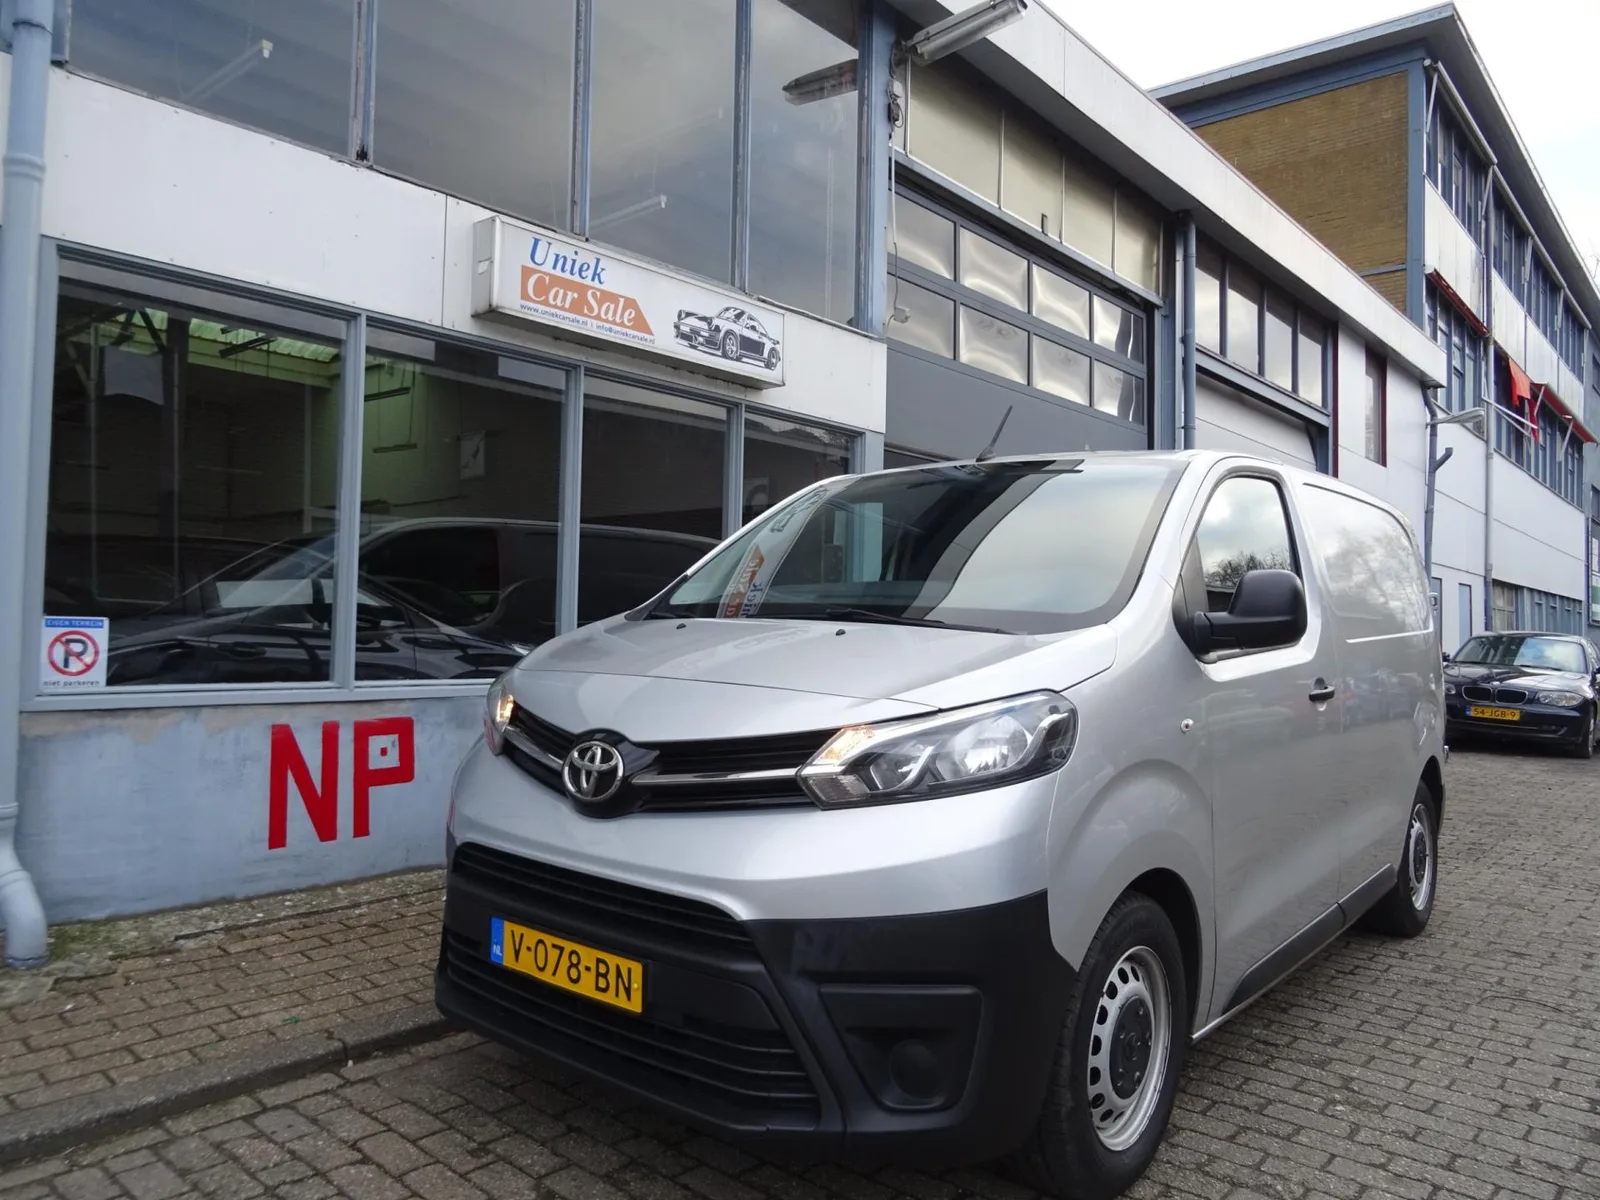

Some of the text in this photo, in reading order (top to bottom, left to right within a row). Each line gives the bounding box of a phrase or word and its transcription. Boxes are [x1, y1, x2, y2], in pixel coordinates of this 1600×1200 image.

[530, 237, 606, 285] Uniek
[520, 303, 589, 326] www.uniekcarsale.nl
[595, 324, 656, 344] info@uniekcarsale.nl
[527, 273, 636, 326] Car Sale
[63, 680, 100, 688] parkeren
[1473, 709, 1517, 719] 54-JGB-9
[268, 716, 415, 850] NP
[511, 929, 632, 1003] V-078-BN
